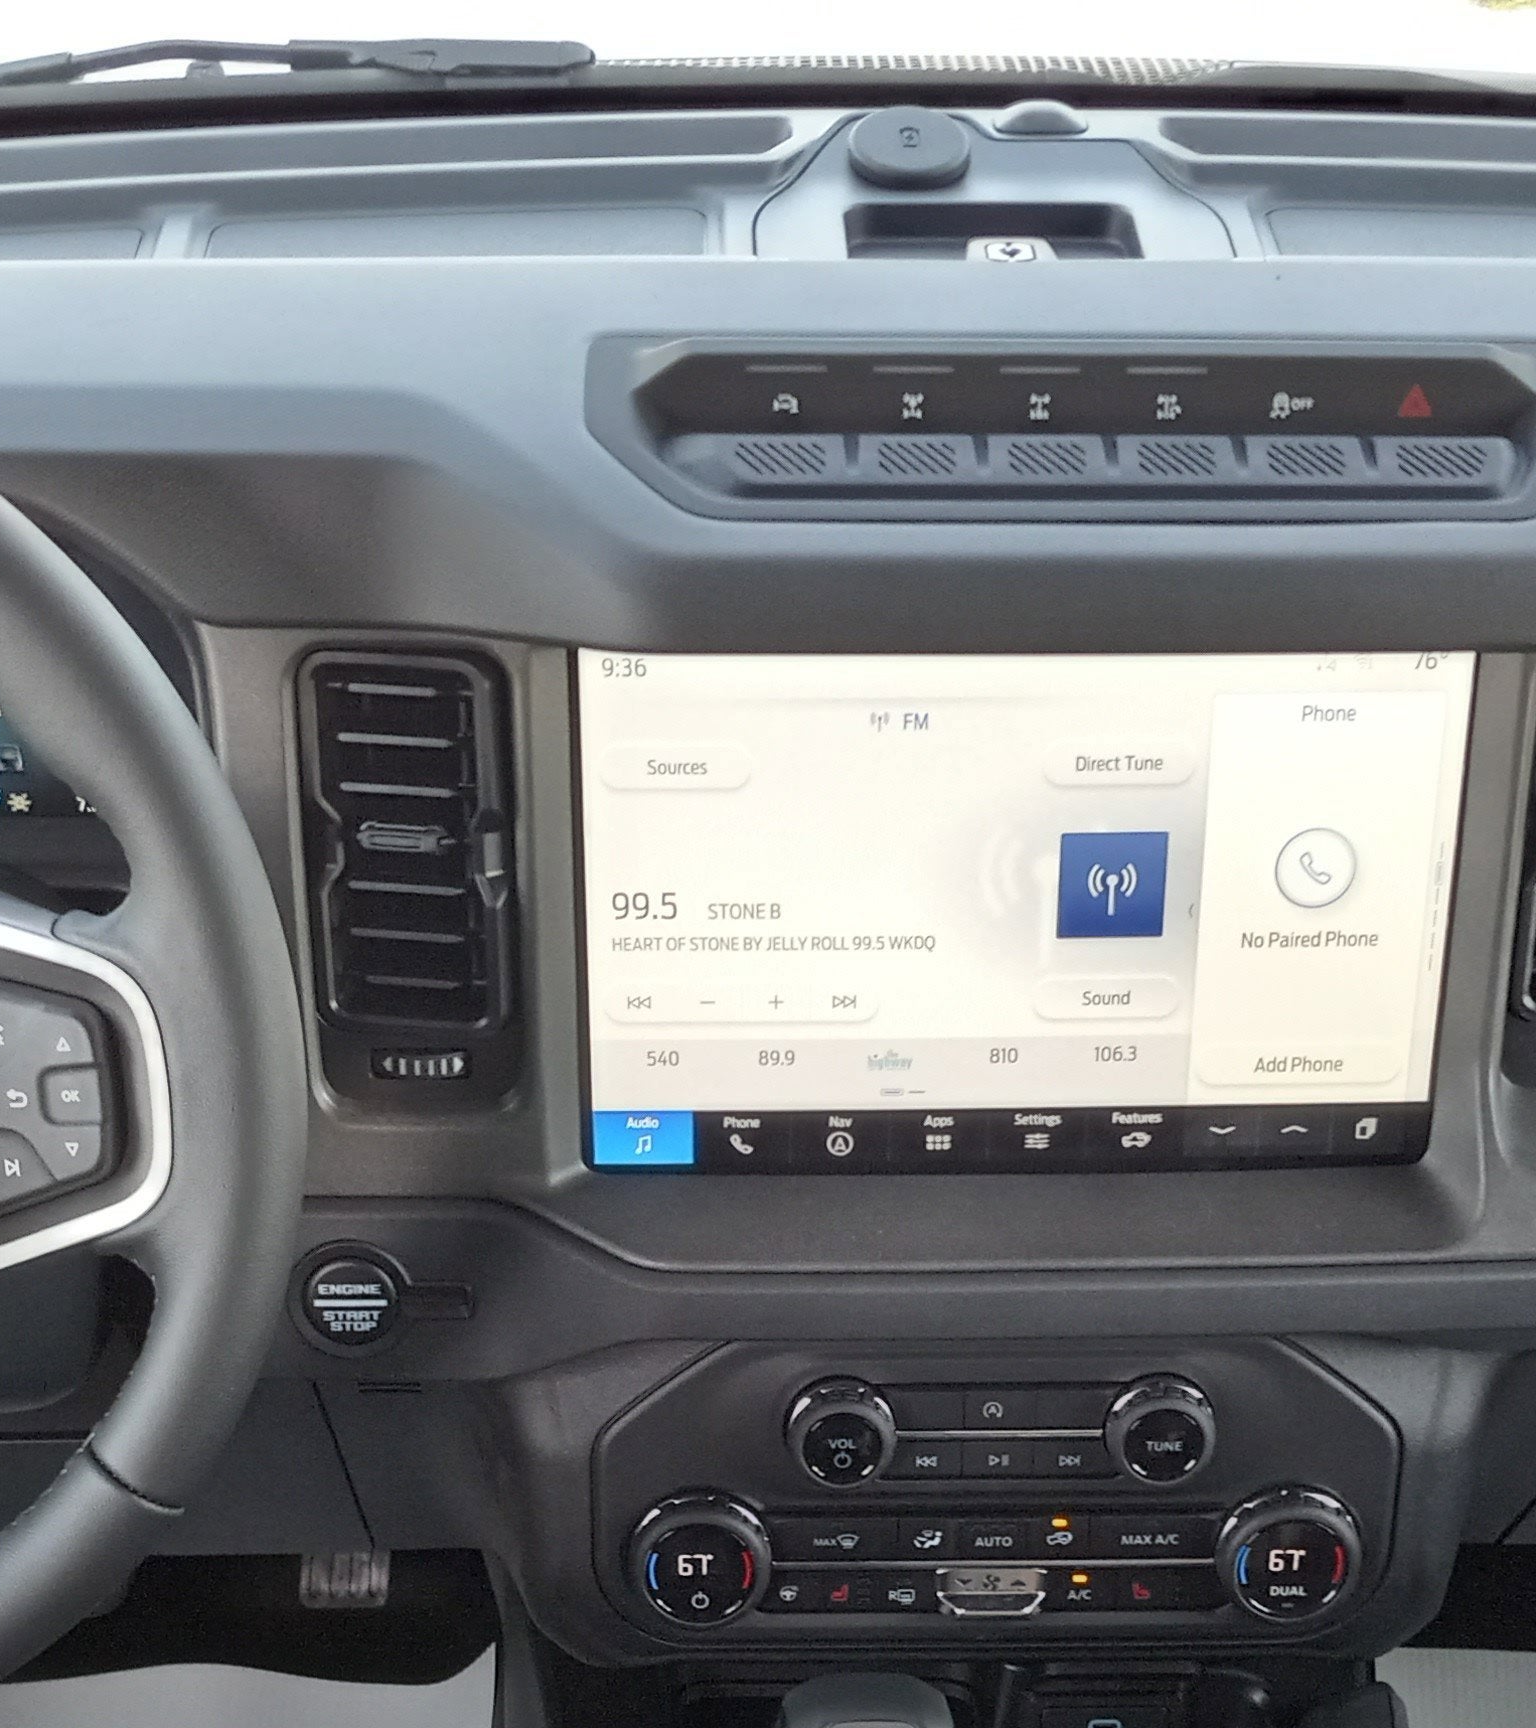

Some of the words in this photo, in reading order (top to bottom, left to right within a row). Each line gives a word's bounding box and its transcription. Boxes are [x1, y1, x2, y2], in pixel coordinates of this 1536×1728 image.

[601, 658, 647, 678] 9:36
[1301, 705, 1357, 722] Phone
[903, 713, 929, 731] FM
[647, 759, 708, 776] Sources
[1075, 755, 1120, 772] Direct
[1124, 755, 1163, 771] Tune
[612, 892, 678, 921] 99.5
[708, 903, 766, 920] STONE
[770, 904, 781, 920] B
[612, 937, 662, 952] HEART
[666, 937, 686, 951] OF
[689, 937, 740, 951] STONE
[743, 937, 762, 951] BY
[766, 936, 807, 951] JELLY
[811, 936, 849, 951] ROLL
[852, 936, 885, 951] 99.5
[889, 936, 936, 952] WKDQ
[1240, 932, 1264, 950] No
[1268, 932, 1322, 949] Paired
[1325, 931, 1379, 948] Phone
[1082, 990, 1131, 1007] Sound
[646, 1050, 680, 1067] 540
[758, 1049, 795, 1067] 89.9
[989, 1048, 1018, 1065] 810
[1094, 1046, 1137, 1063] 106.3
[1254, 1057, 1287, 1073] Add
[1291, 1057, 1343, 1073] Phone
[61, 1089, 80, 1103] OK
[626, 1116, 659, 1129] Audio
[723, 1116, 761, 1130] Phone
[828, 1116, 853, 1128] Nav
[923, 1115, 954, 1130] Apps
[1013, 1113, 1062, 1128] Settings
[1112, 1111, 1163, 1125] Features
[317, 1284, 382, 1295] ENGINE
[323, 1311, 382, 1321] START
[330, 1321, 377, 1332] STOP
[828, 1438, 856, 1450] VOL
[1145, 1441, 1183, 1452] TUNE
[814, 1538, 837, 1547] MAX
[974, 1536, 1013, 1547] AUTO
[1120, 1535, 1152, 1546] MAX
[1154, 1534, 1179, 1545] A/C
[1067, 1589, 1092, 1600] A/C
[1269, 1586, 1307, 1597] DUAL
